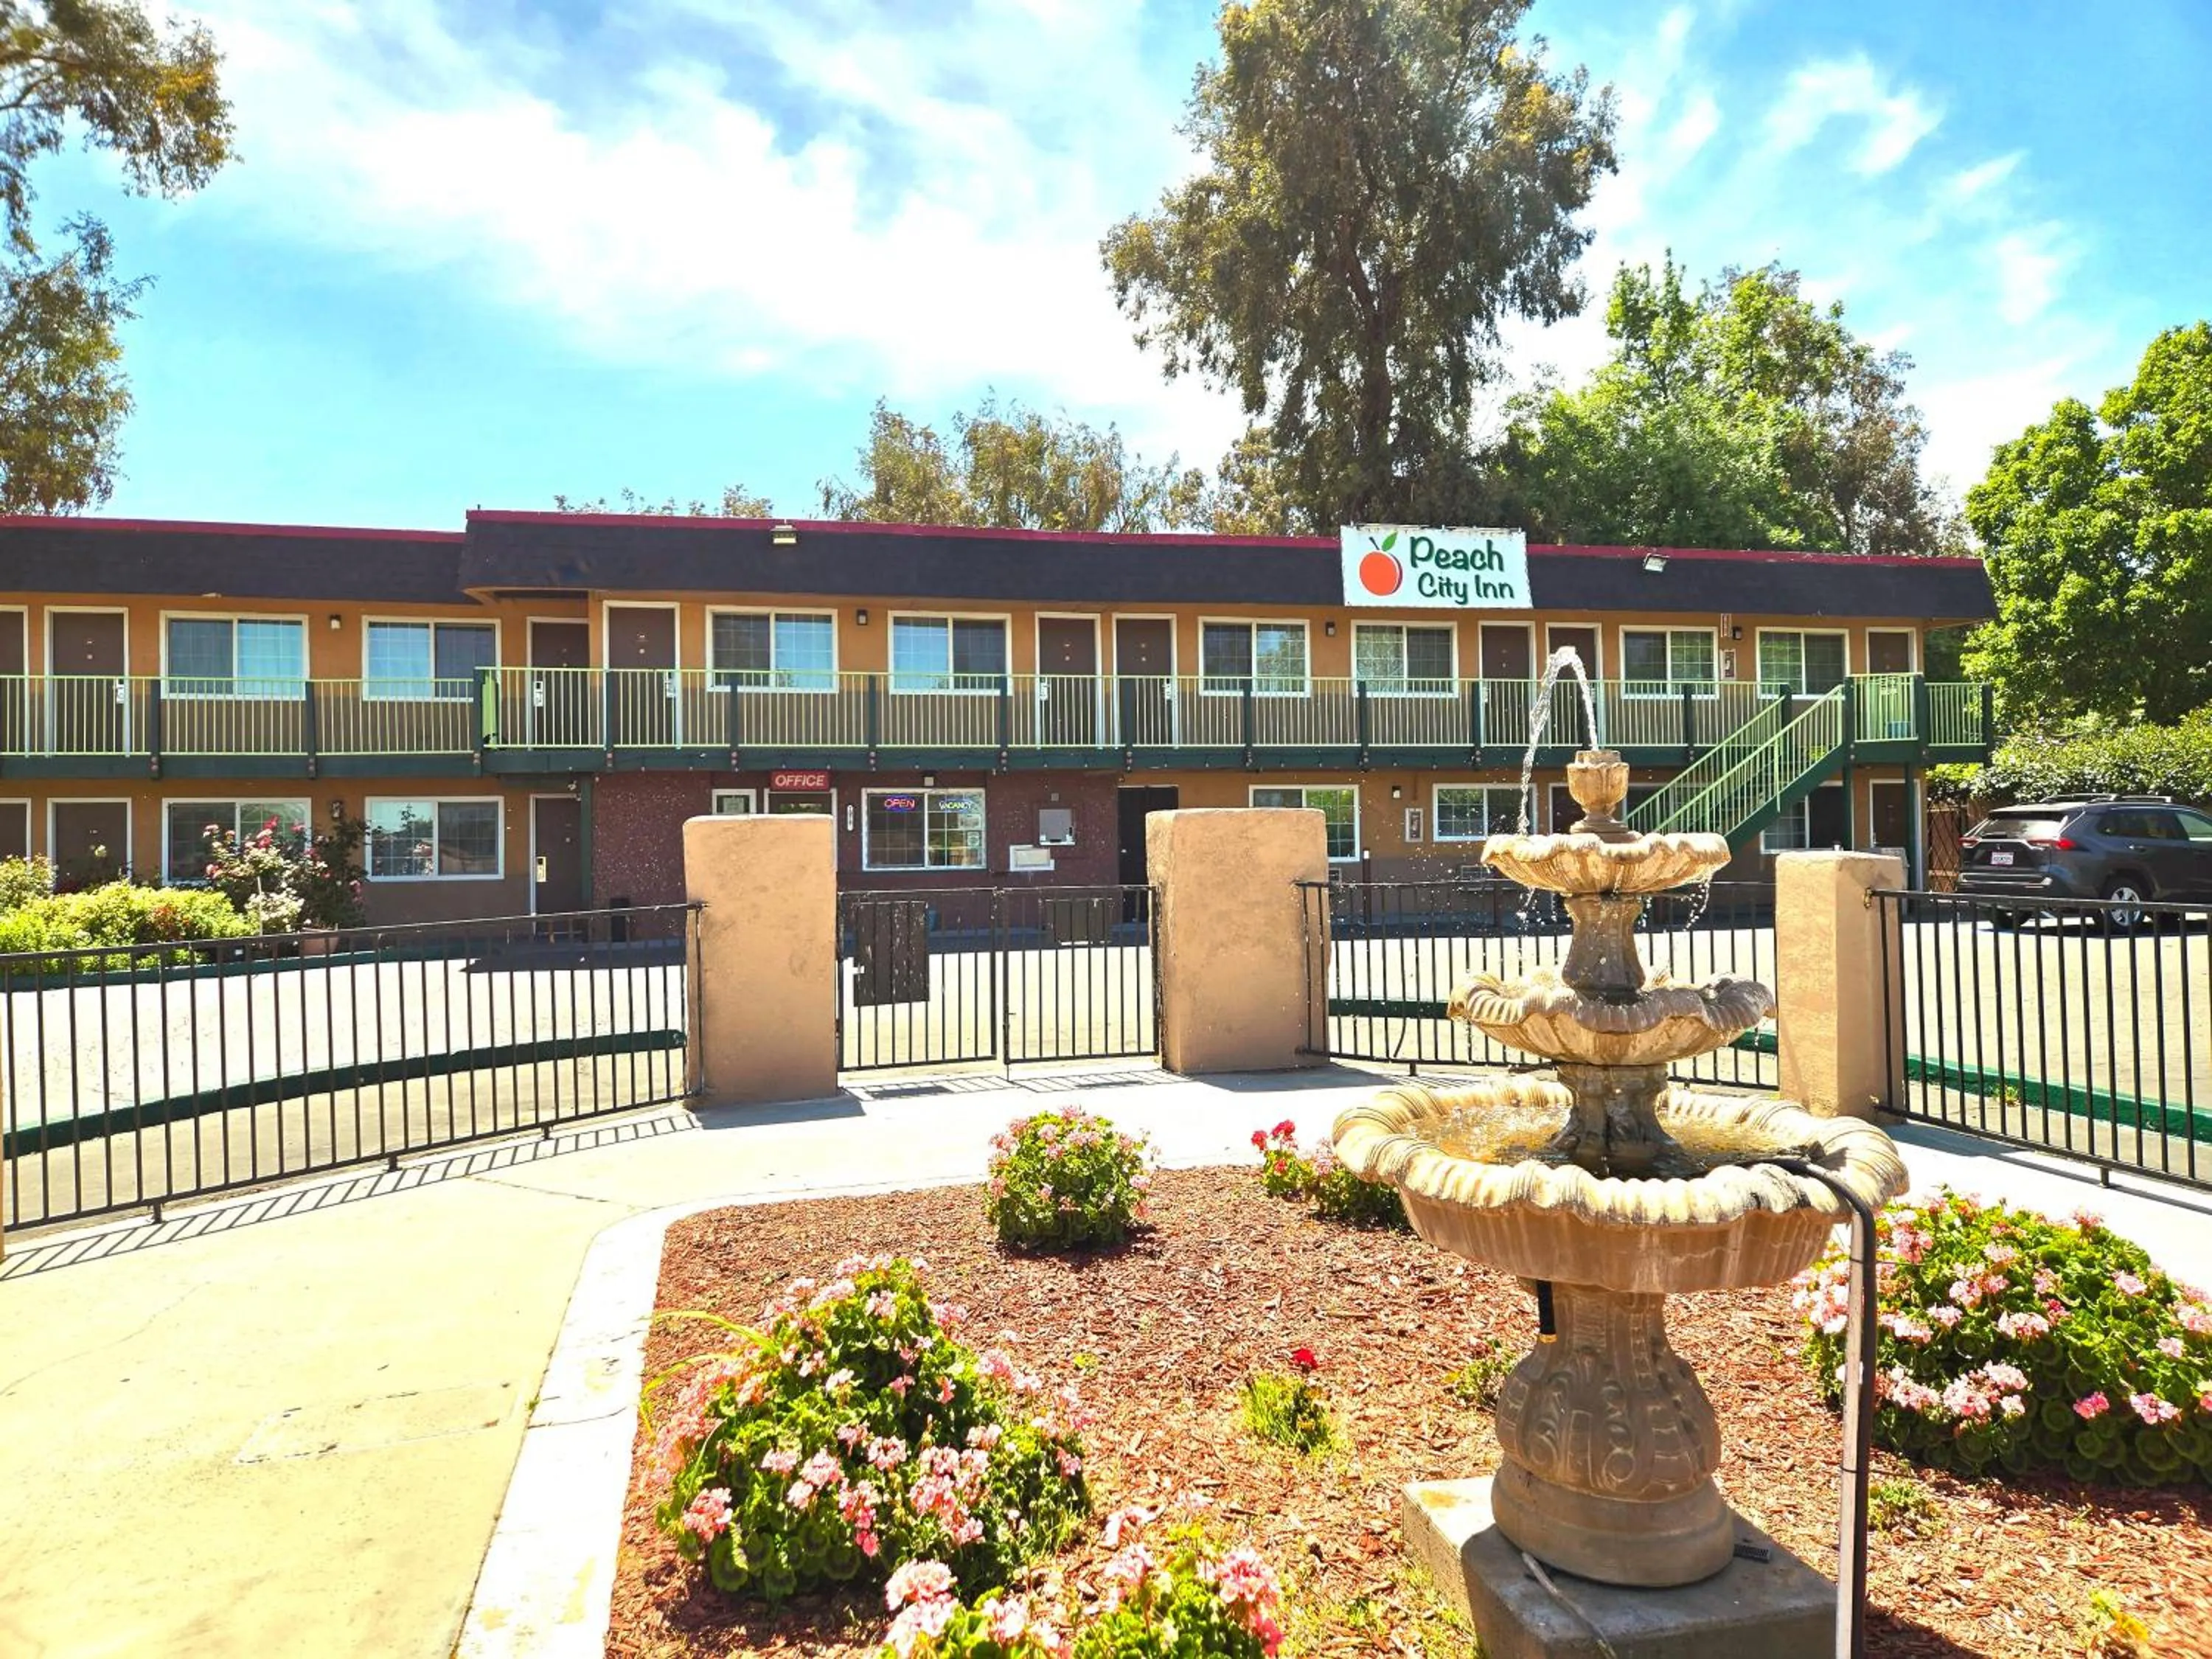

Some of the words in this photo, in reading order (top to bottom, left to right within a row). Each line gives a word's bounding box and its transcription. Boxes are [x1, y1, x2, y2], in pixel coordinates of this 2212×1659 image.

[1410, 536, 1504, 571] Peach
[1418, 571, 1469, 605] City
[1475, 574, 1515, 599] Inn
[775, 774, 826, 787] OFFICE
[884, 799, 916, 809] OPEN
[939, 800, 972, 810] VACANCY
